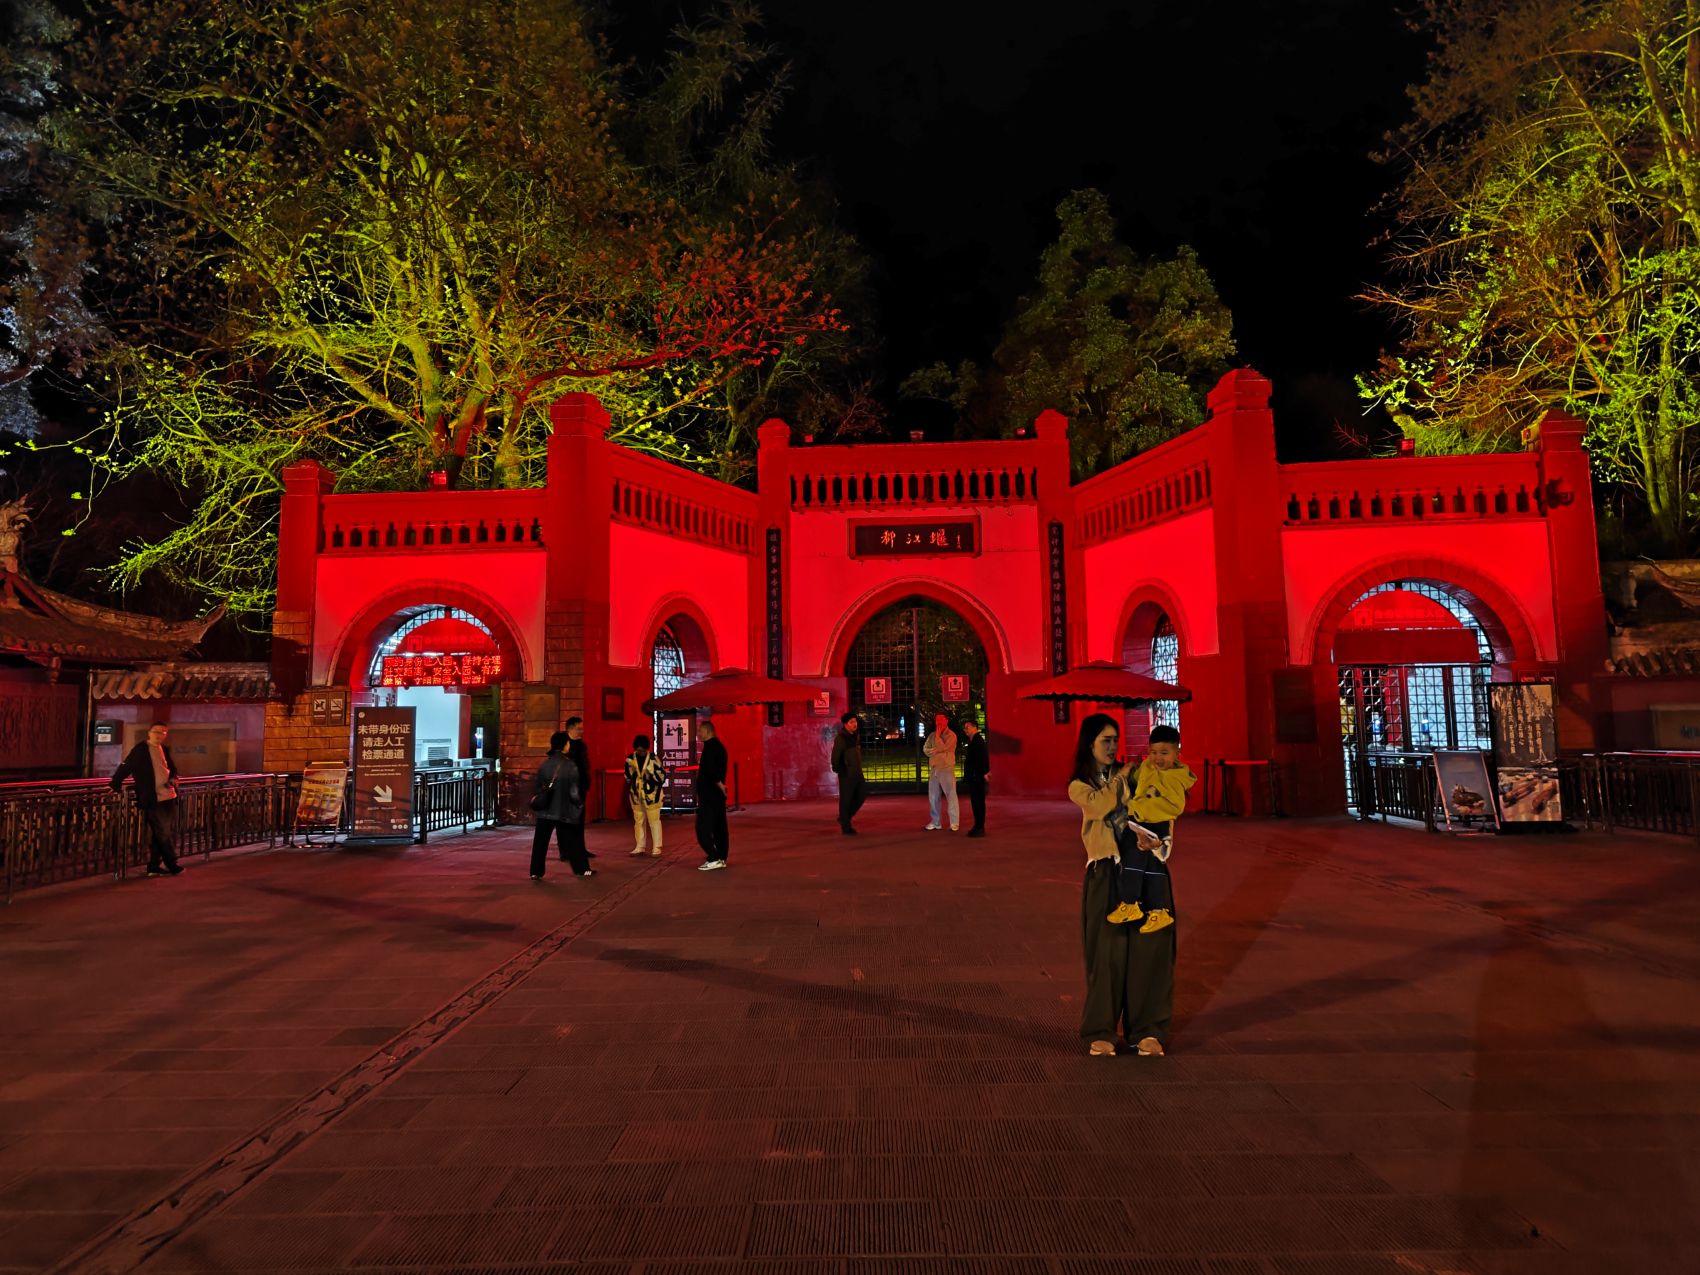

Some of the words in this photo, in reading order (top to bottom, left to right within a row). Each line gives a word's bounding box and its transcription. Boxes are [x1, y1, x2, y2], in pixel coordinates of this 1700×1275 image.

[881, 528, 949, 548] 都江堰
[358, 724, 411, 735] 未带身份证
[362, 736, 405, 747] 请走人工
[362, 749, 405, 760] 检票通道
